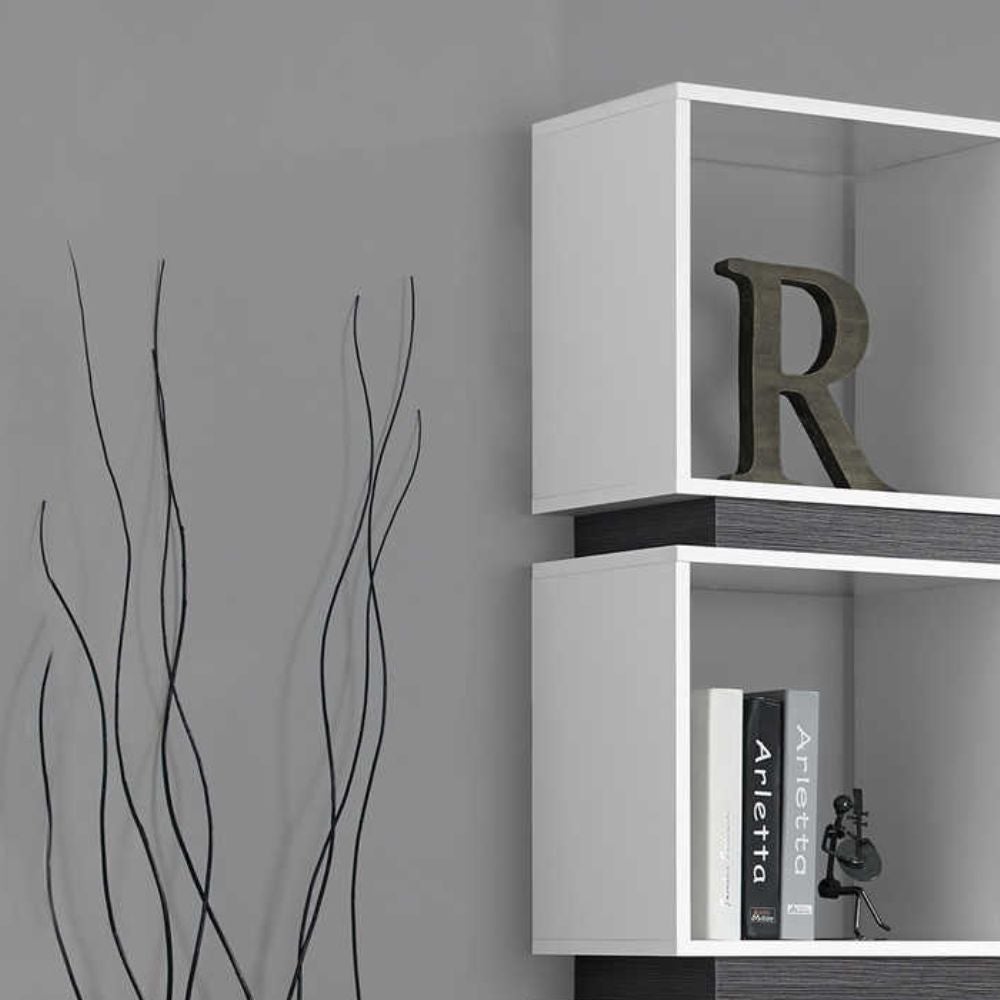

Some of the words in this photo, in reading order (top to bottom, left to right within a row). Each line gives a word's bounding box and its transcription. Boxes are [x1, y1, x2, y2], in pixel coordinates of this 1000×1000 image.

[714, 258, 899, 491] R
[753, 738, 772, 883] Arletta
[794, 723, 812, 875] Arletta
